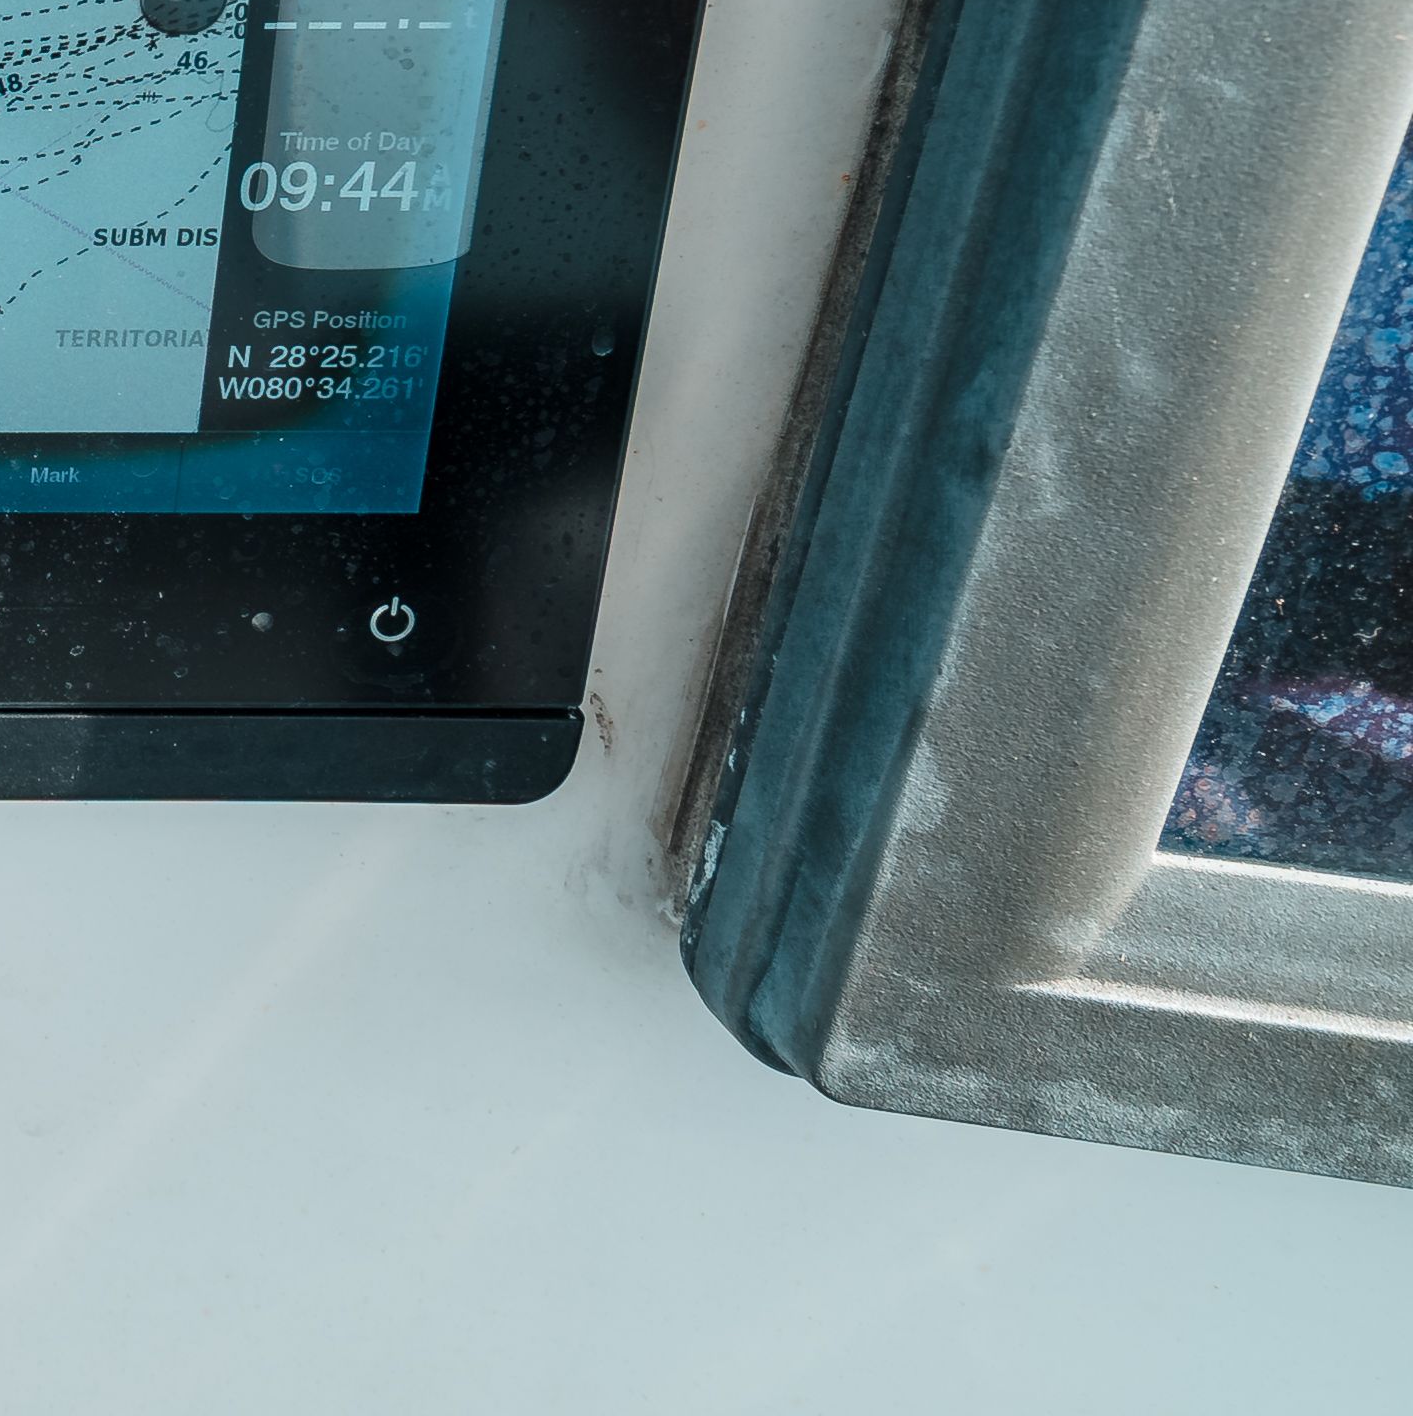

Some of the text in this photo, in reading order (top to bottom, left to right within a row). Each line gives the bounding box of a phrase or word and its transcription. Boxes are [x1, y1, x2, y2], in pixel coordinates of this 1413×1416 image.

[177, 51, 207, 69] 46
[280, 132, 424, 155] Time of Day
[241, 161, 418, 212] 09:44
[93, 228, 218, 247] SUBM DIS
[254, 311, 406, 330] GPS Position
[228, 346, 252, 368] N
[31, 467, 80, 485] Mark
